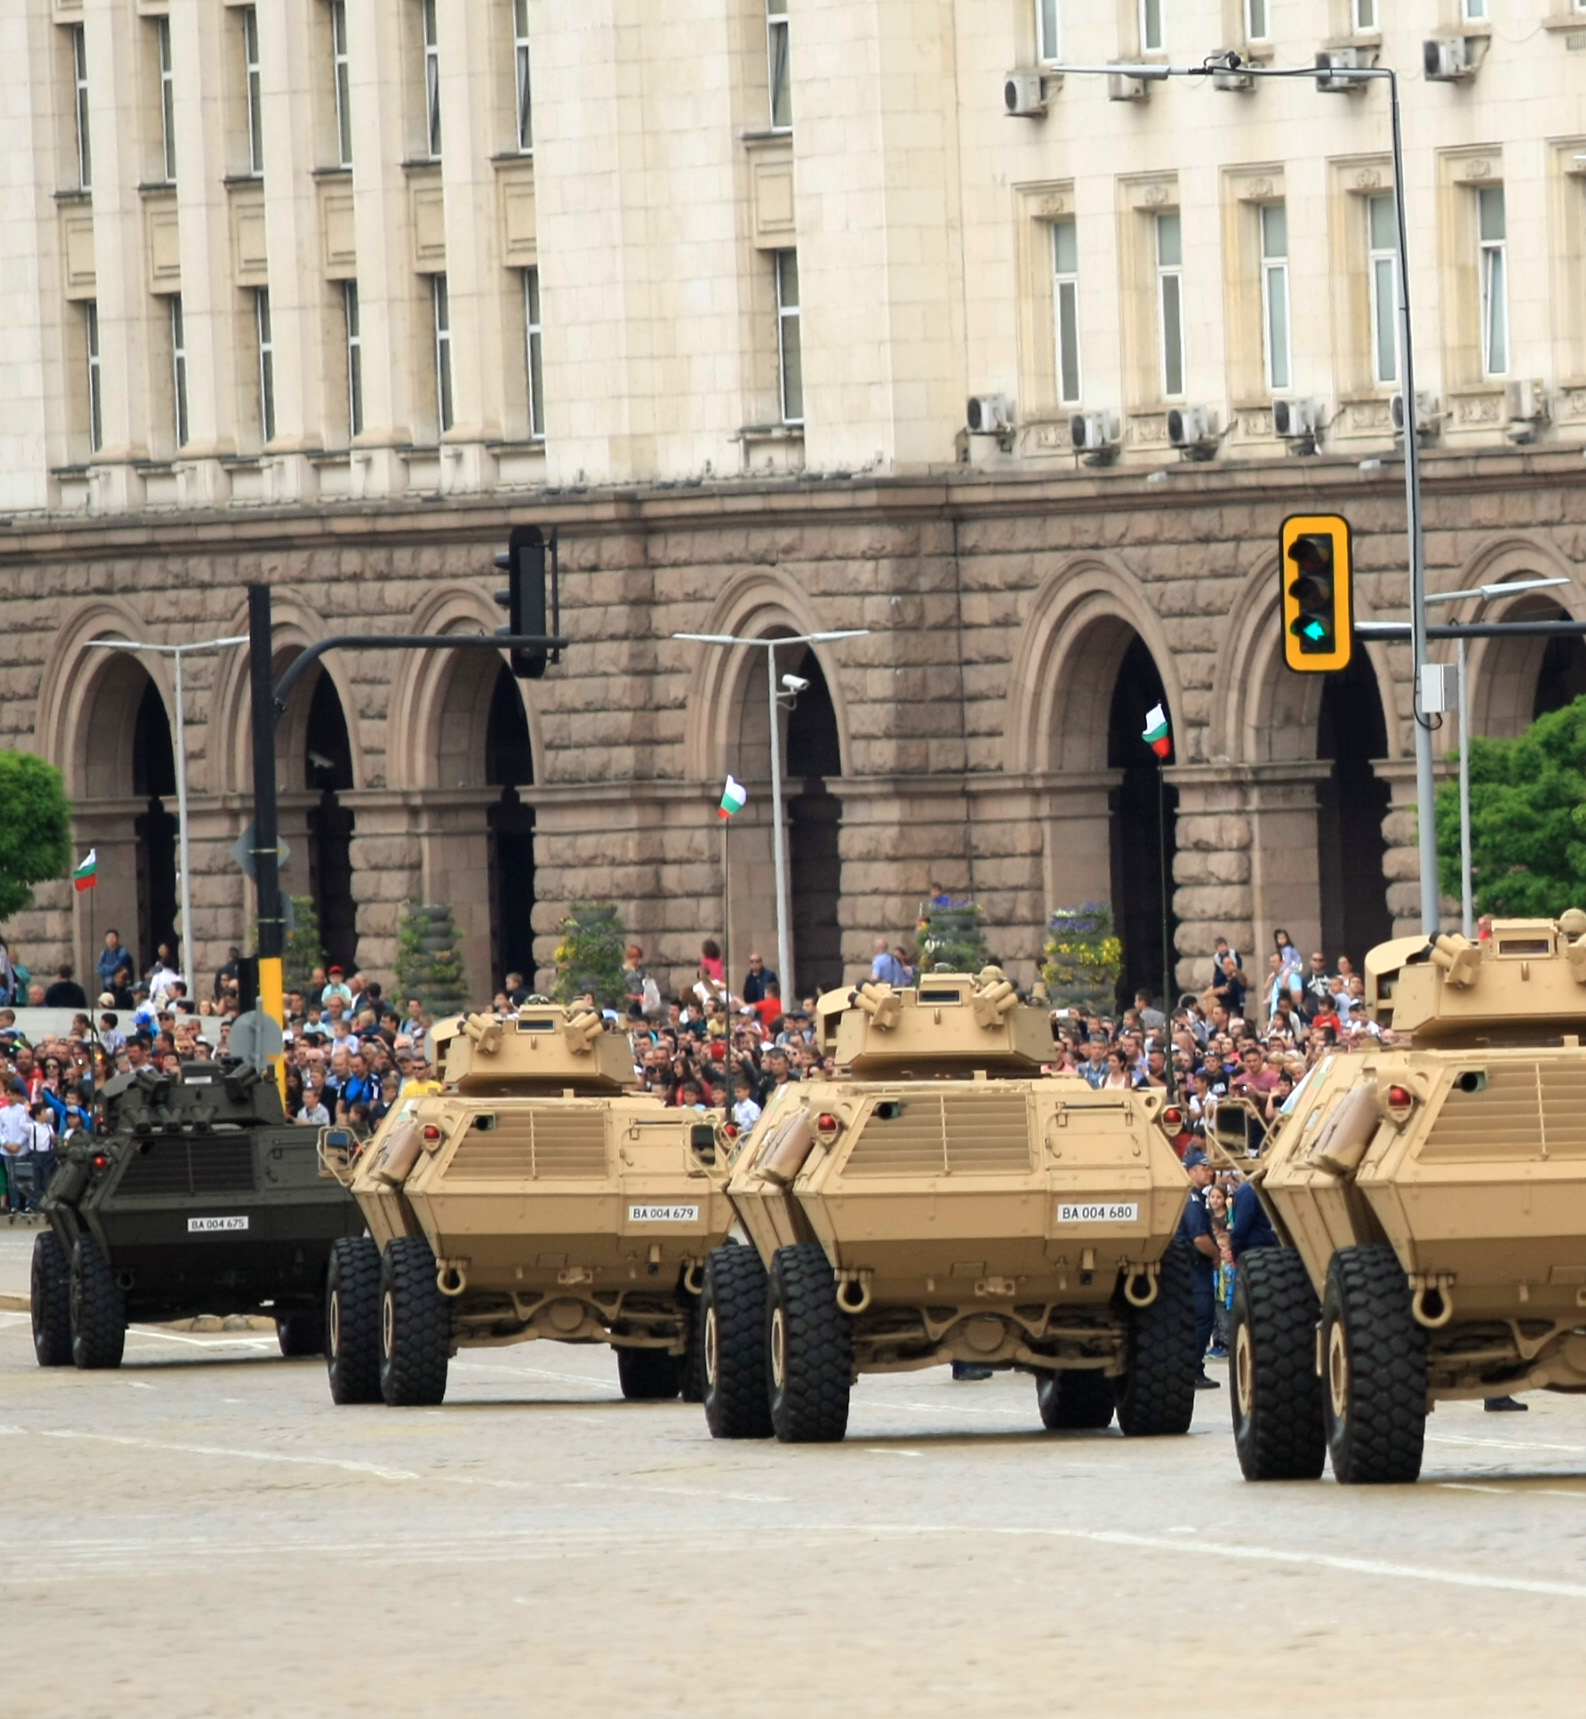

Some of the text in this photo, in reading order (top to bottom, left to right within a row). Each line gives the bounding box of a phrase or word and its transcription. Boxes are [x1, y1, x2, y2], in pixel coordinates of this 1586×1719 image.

[633, 1208, 694, 1219] BA 004 679
[1062, 1206, 1132, 1219] BA 004 680
[191, 1218, 245, 1230] BA 004 675
